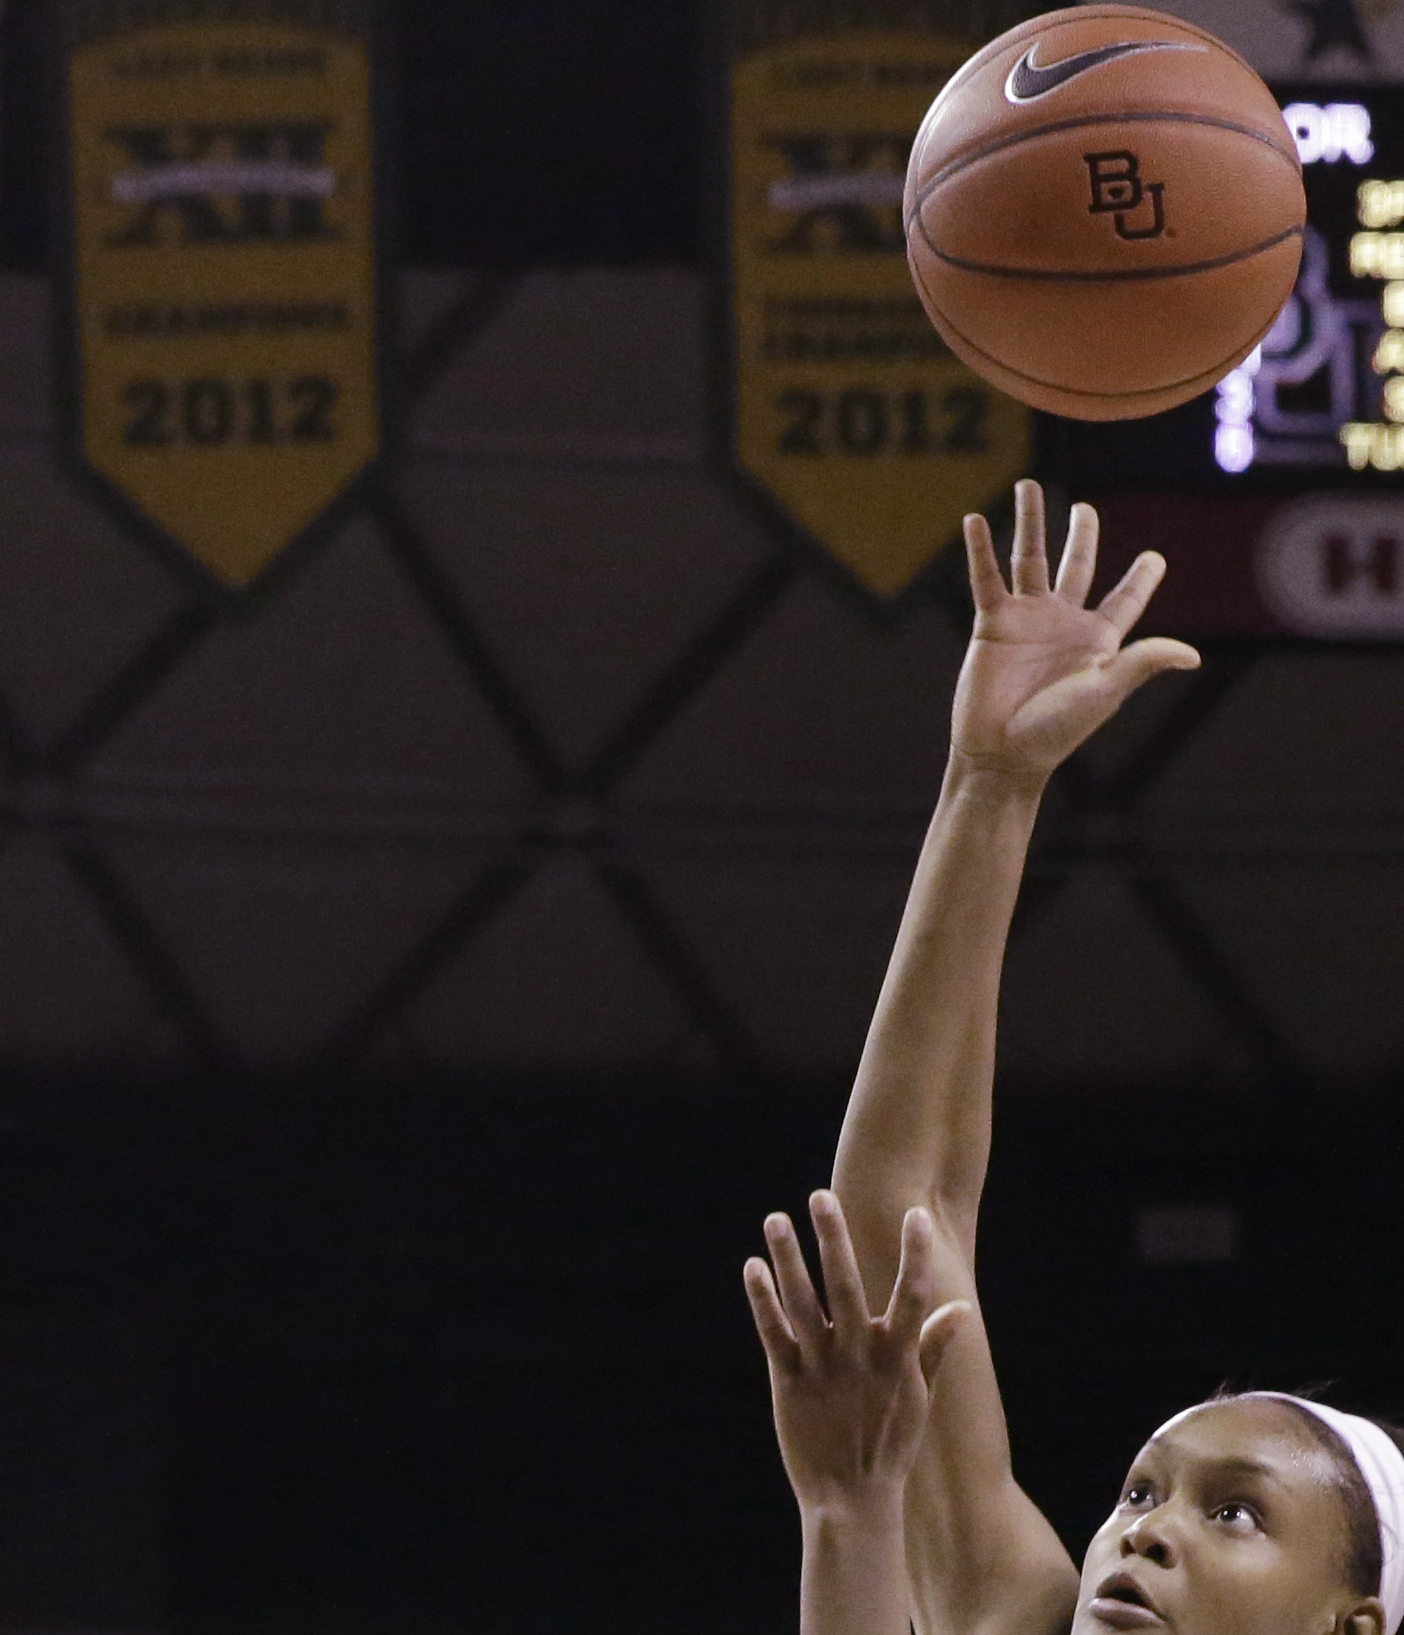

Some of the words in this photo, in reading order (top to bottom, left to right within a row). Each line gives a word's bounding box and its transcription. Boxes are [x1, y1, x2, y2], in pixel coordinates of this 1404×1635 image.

[1083, 149, 1165, 241] BU
[122, 377, 339, 448] 2012
[777, 384, 991, 458] 2012
